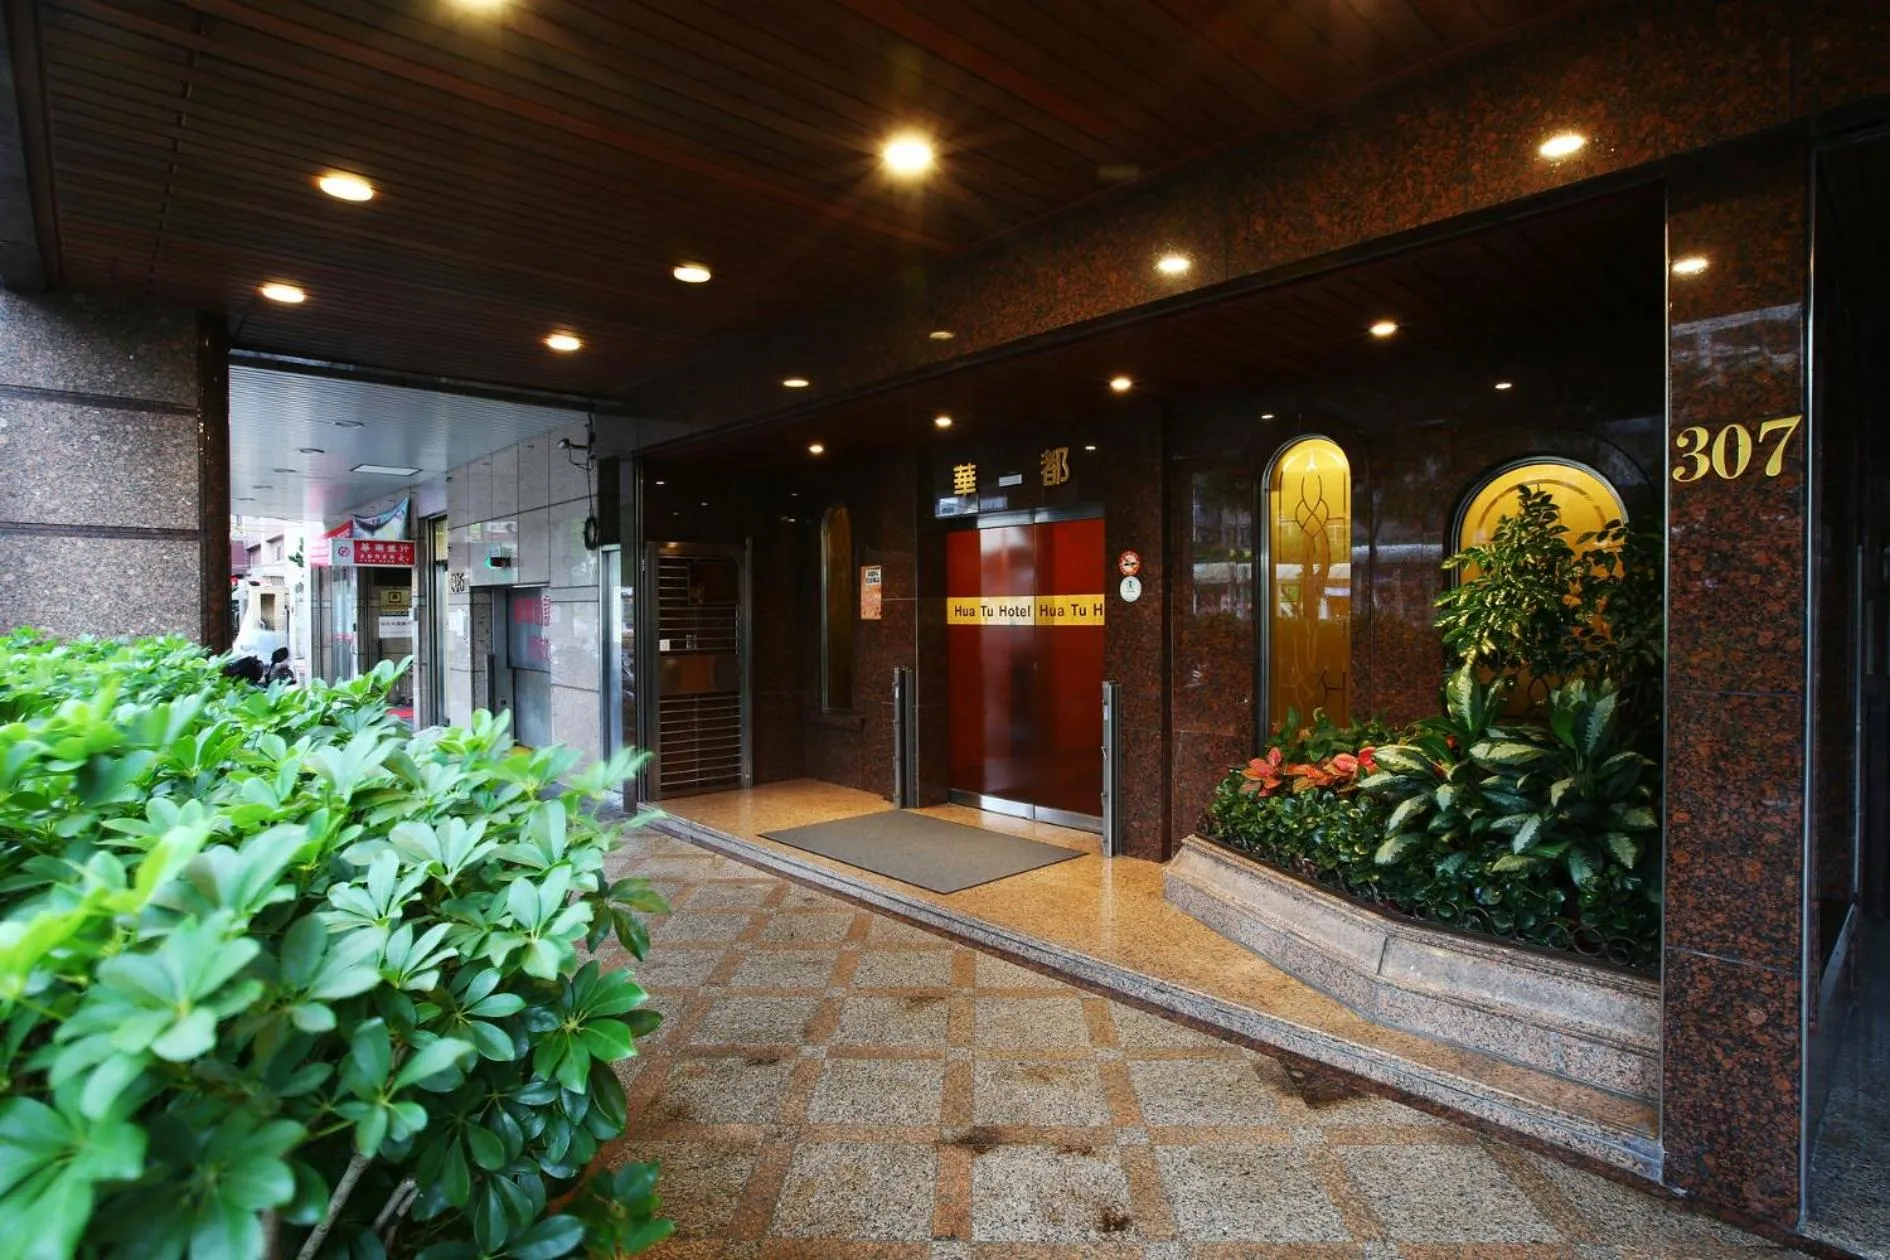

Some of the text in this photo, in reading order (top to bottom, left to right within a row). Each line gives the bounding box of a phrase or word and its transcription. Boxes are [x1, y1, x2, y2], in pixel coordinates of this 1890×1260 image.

[1672, 415, 1803, 483] 307
[954, 606, 976, 617] Hua
[980, 605, 994, 617] Tu
[999, 605, 1031, 617] Hotel
[1039, 604, 1065, 617] Hua
[1071, 604, 1087, 616] Tu
